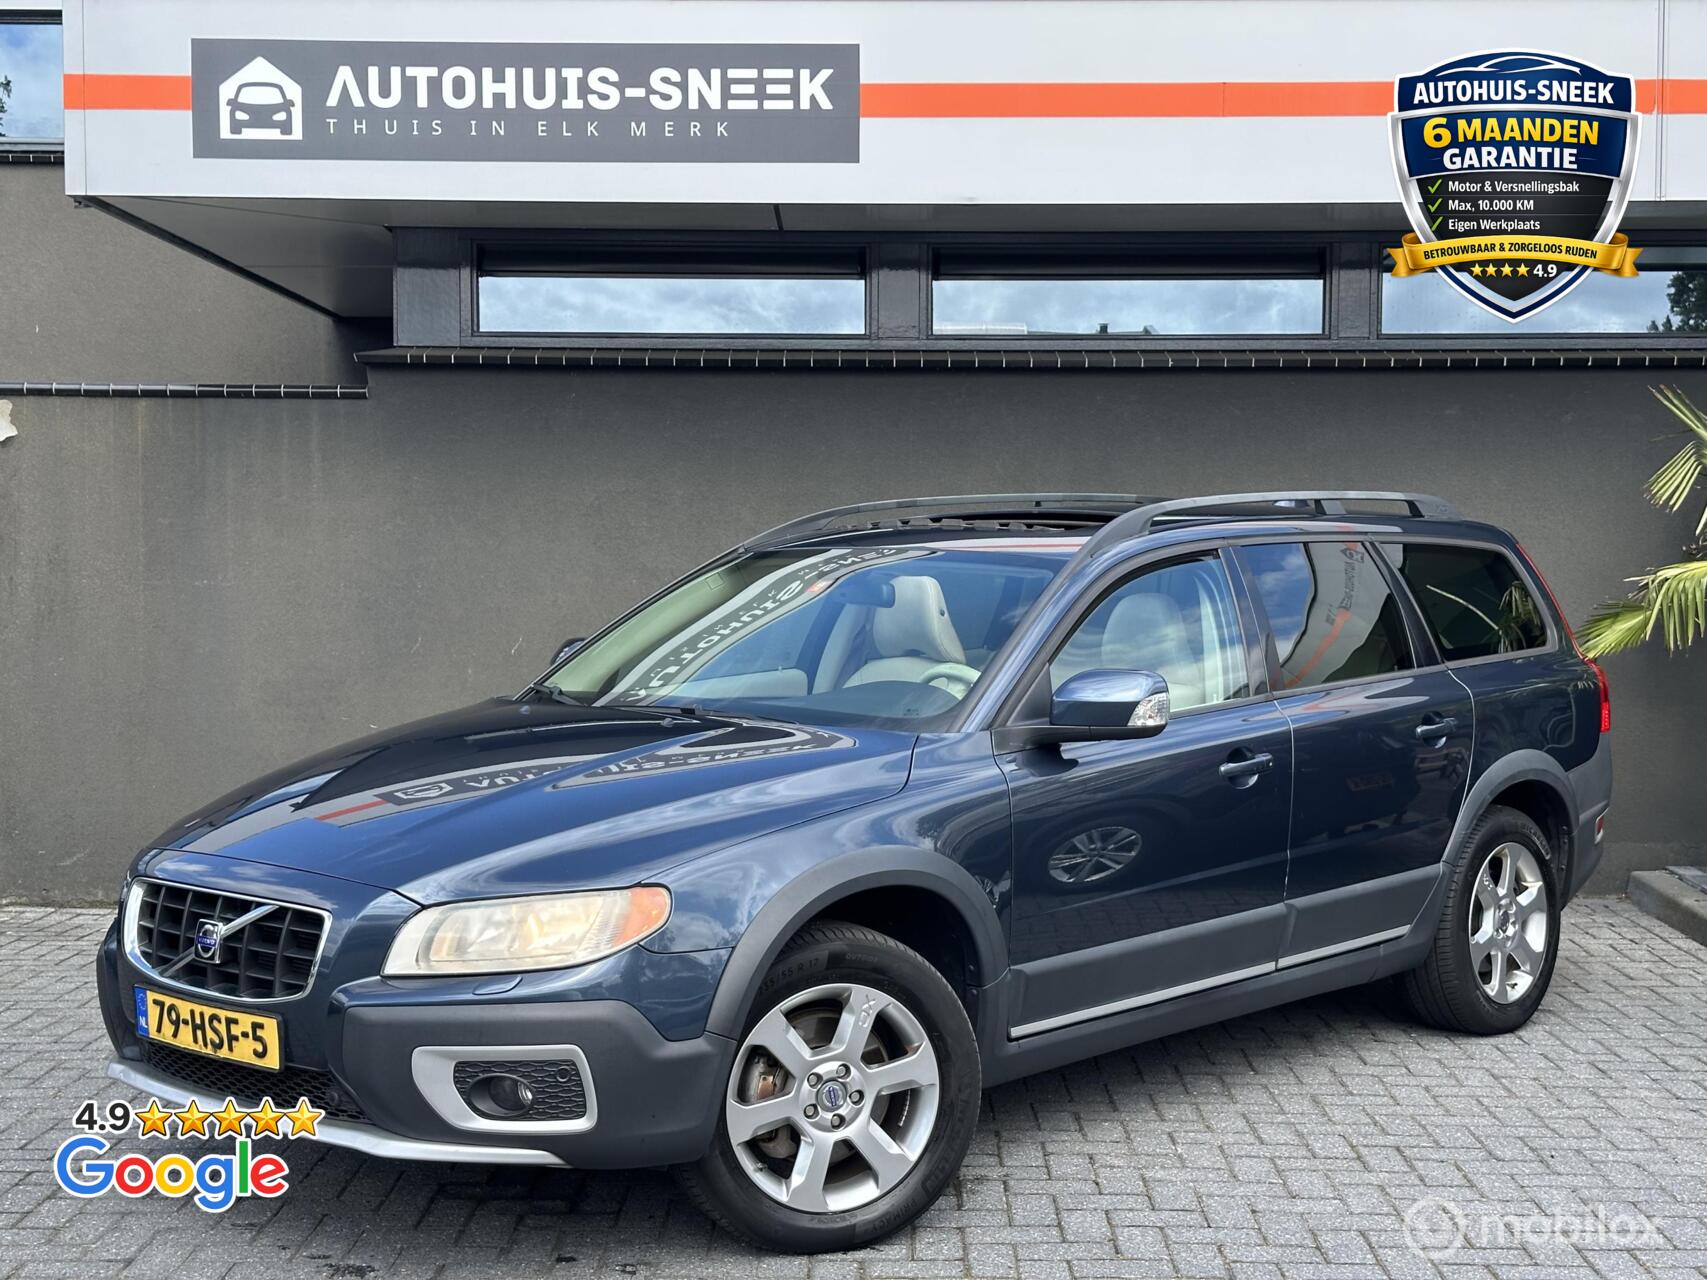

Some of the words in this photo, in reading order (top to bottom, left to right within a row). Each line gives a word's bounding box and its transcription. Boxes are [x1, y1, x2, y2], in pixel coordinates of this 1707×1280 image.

[325, 65, 834, 111] AUTOHUIS-SNEEK
[326, 118, 442, 136] THUIS
[470, 120, 505, 136] IN
[537, 121, 599, 136] ELK
[630, 122, 728, 137] MERK
[139, 1014, 148, 1028] NL
[152, 998, 268, 1059] 79-HSF-5
